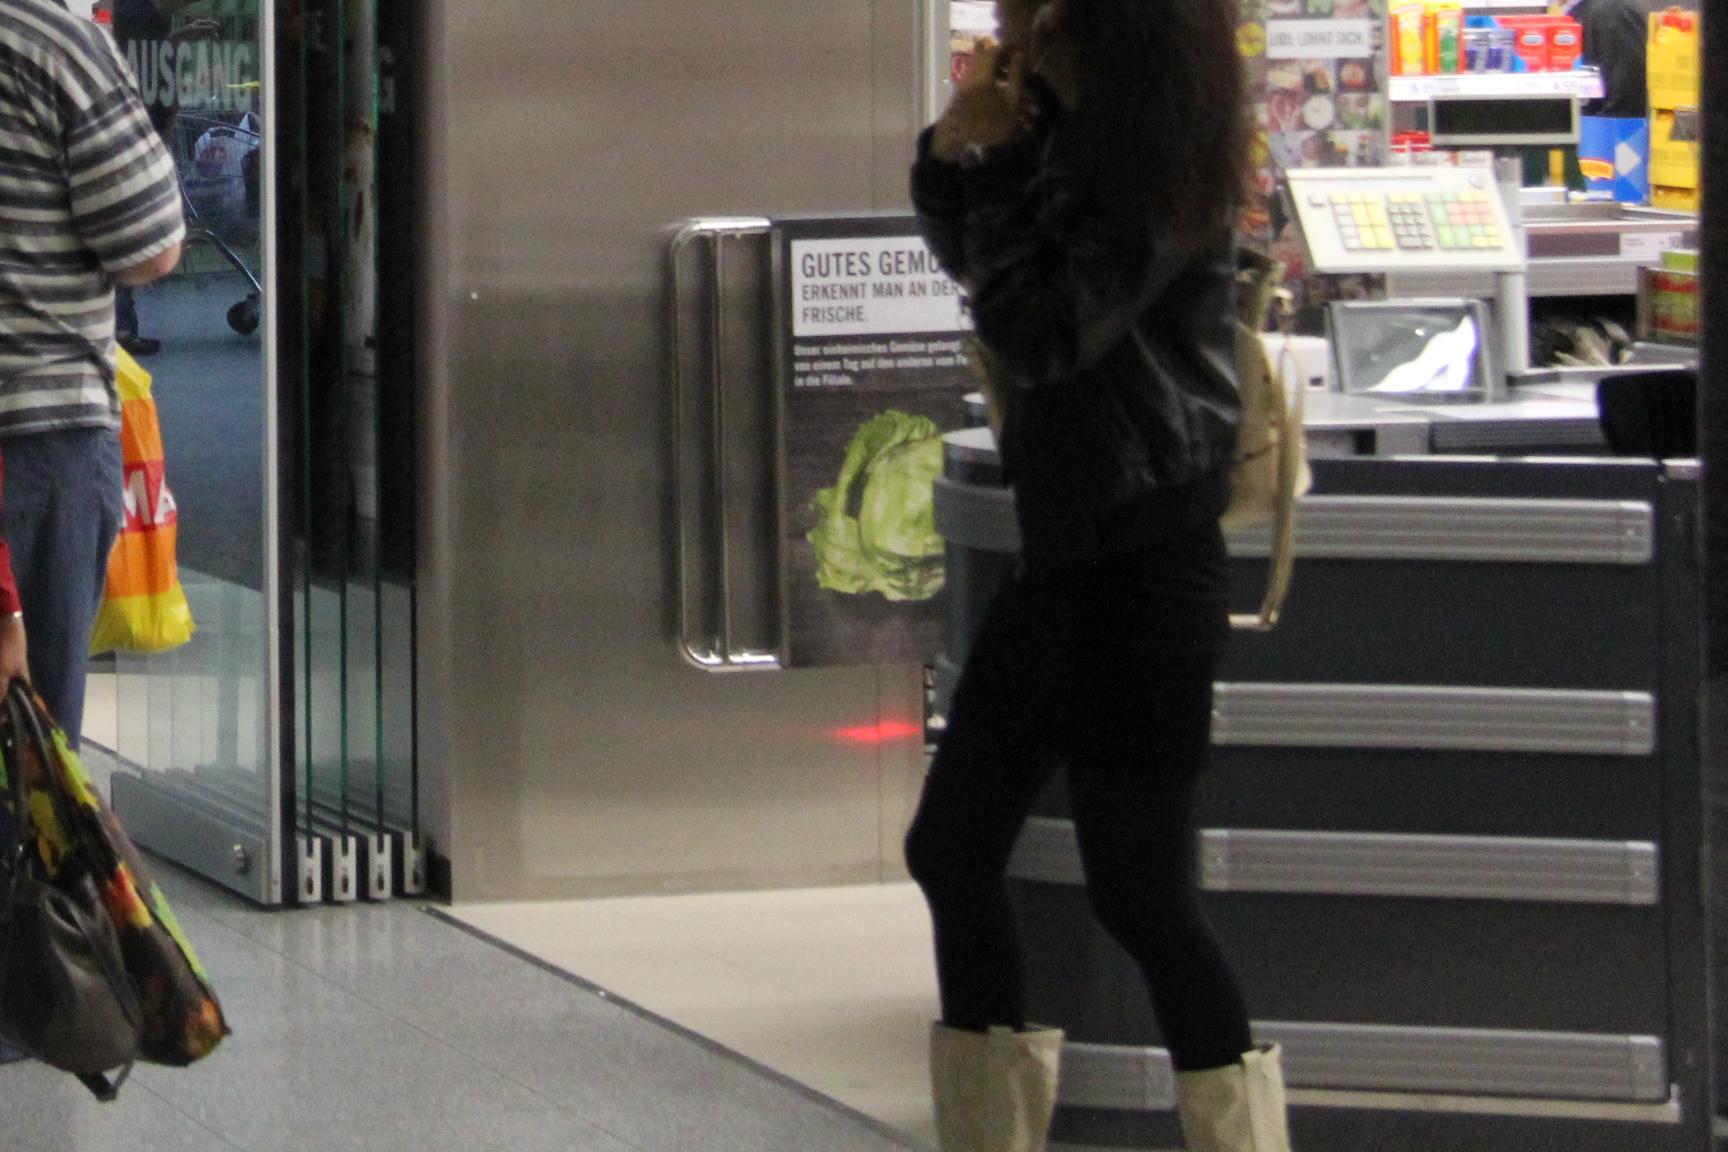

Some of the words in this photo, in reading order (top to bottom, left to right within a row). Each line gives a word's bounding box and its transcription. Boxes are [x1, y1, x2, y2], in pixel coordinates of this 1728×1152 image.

[126, 39, 252, 112] AUSGANG
[801, 252, 871, 278] GUTES
[802, 283, 867, 301] ERKENNT
[872, 282, 904, 298] MAN
[908, 281, 926, 297] AN
